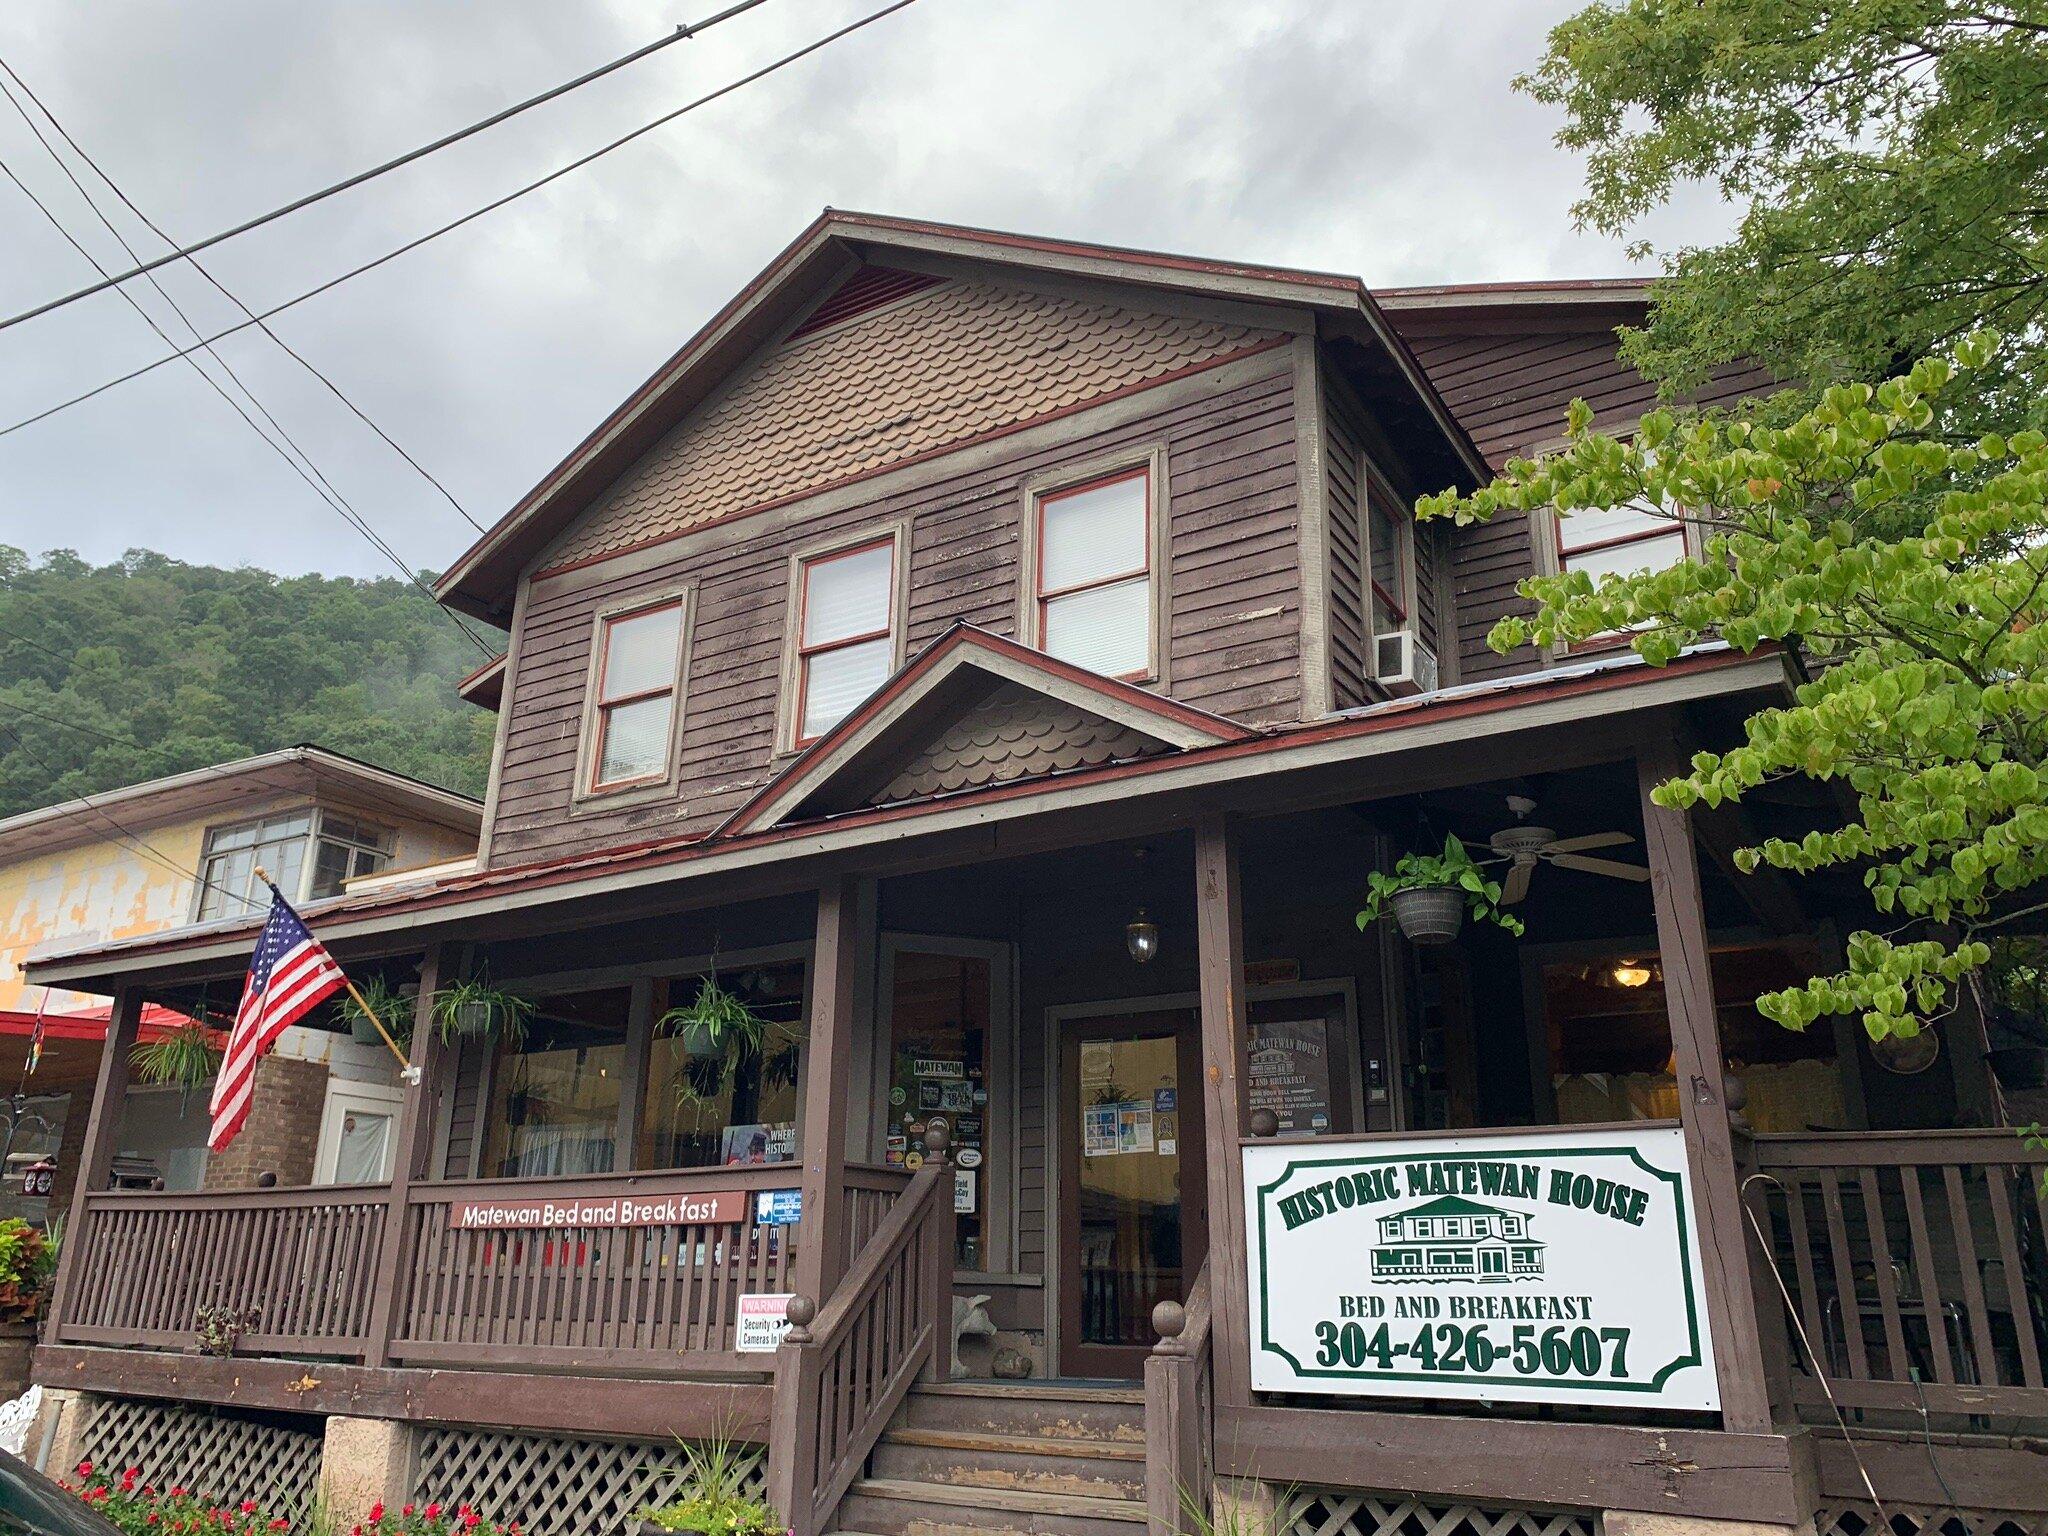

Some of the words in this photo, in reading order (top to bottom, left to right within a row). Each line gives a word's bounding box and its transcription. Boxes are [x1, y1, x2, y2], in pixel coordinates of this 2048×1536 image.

[915, 1060, 962, 1076] MATEWAN
[1277, 1163, 1400, 1230] HISTORIC
[1406, 1161, 1540, 1199] MATEWAN
[1547, 1169, 1649, 1227] HOUSE
[462, 1206, 540, 1227] Matewan
[543, 1202, 579, 1226] Bed
[582, 1200, 616, 1223] and
[1340, 1295, 1385, 1318] BED
[1394, 1295, 1440, 1319] AND
[1450, 1295, 1592, 1320] BREAKFAST
[744, 1318, 770, 1332] Security
[744, 1333, 769, 1344] Cameras
[1315, 1320, 1630, 1377] 304-426-5607
